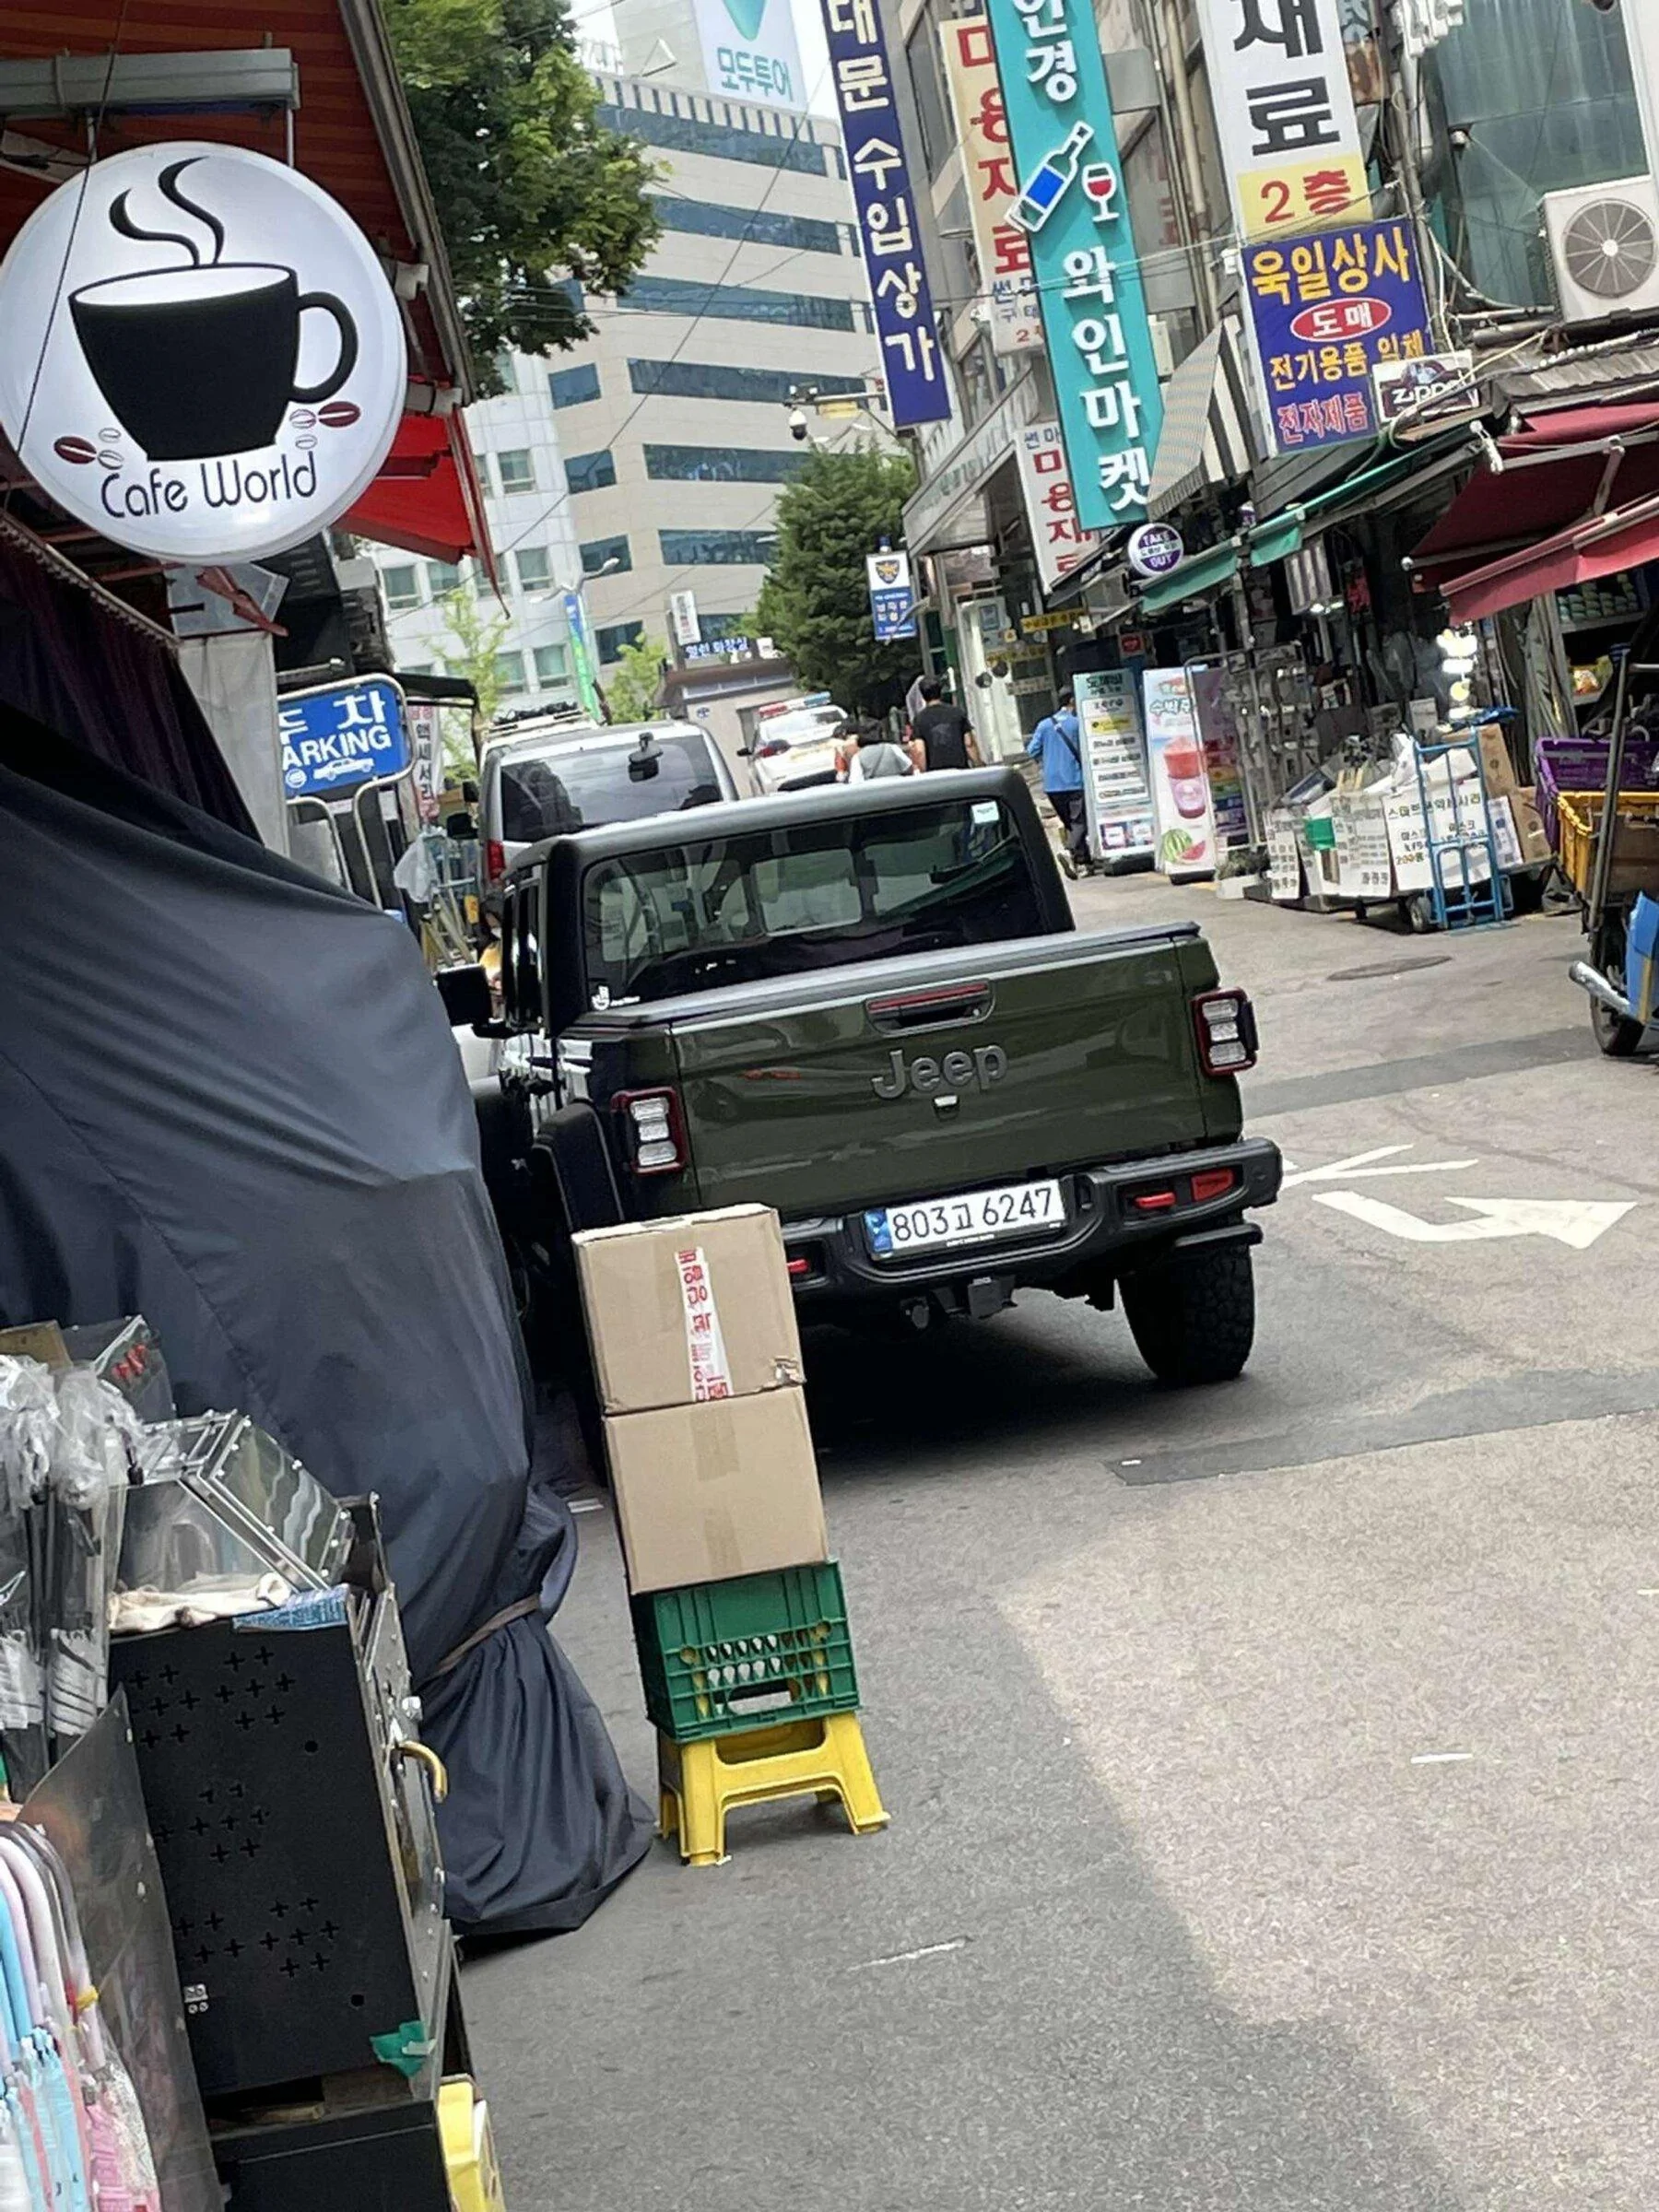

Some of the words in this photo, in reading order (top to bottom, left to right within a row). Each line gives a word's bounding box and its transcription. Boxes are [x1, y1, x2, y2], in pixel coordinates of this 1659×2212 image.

[717, 47, 794, 101] 모두투어
[1233, 0, 1341, 156] 재료
[1260, 170, 1351, 224] 2층
[1251, 226, 1410, 306] 욱일상사
[1311, 300, 1374, 337] 도매
[1269, 341, 1368, 392] 전기용품
[1277, 392, 1369, 445] 전자제품
[101, 468, 188, 519] Cafe
[200, 452, 317, 509] World
[1149, 554, 1172, 568] OUT
[282, 724, 394, 771] ARKING
[870, 1044, 1008, 1100] Jeep
[982, 1187, 1053, 1227] 6247
